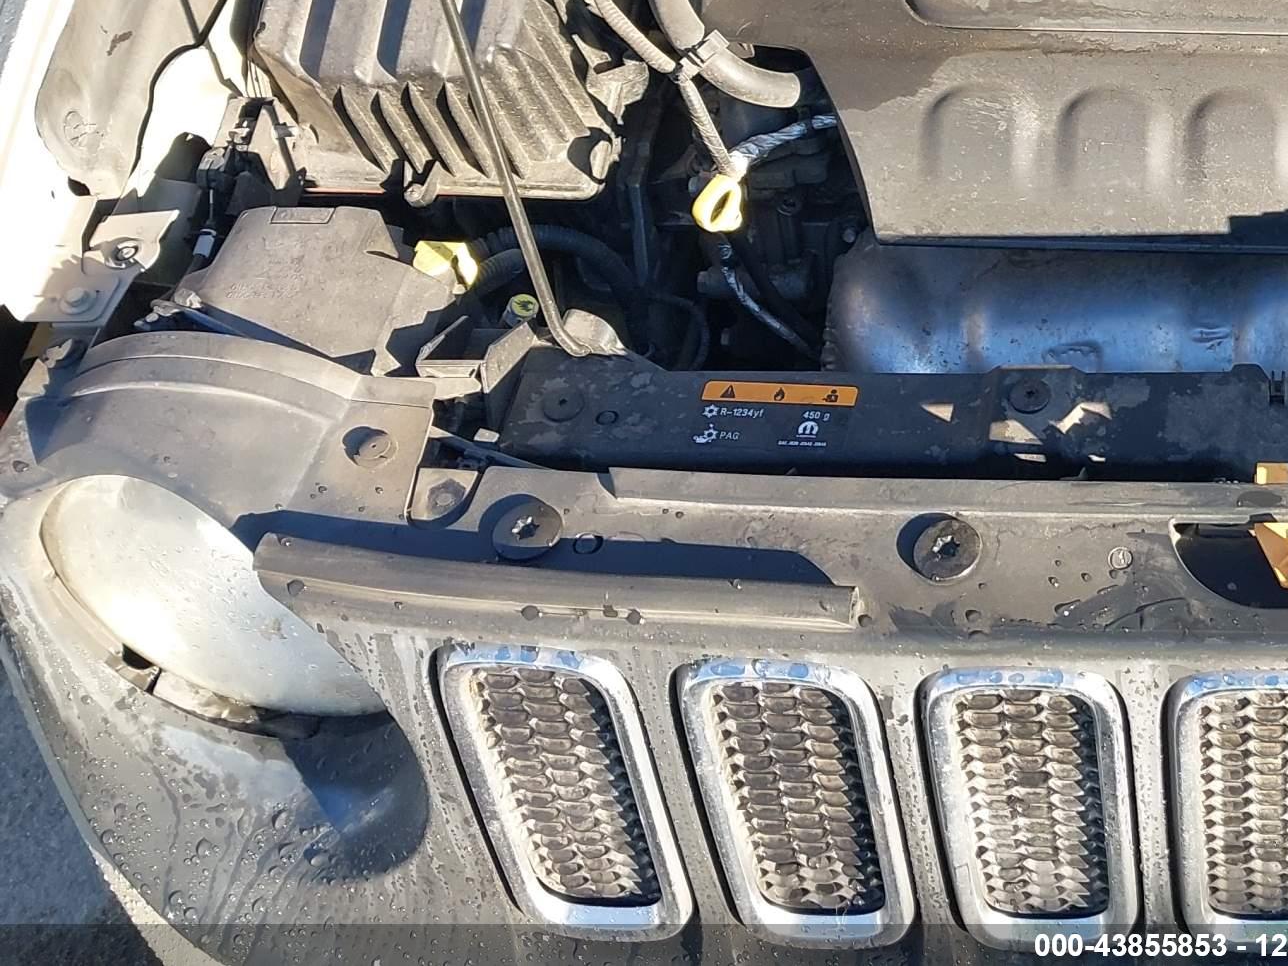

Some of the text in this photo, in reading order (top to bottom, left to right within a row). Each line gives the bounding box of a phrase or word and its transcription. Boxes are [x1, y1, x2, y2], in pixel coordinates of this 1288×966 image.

[719, 407, 765, 419] R-1234yf
[802, 410, 821, 420] 450
[719, 431, 740, 441] PAG
